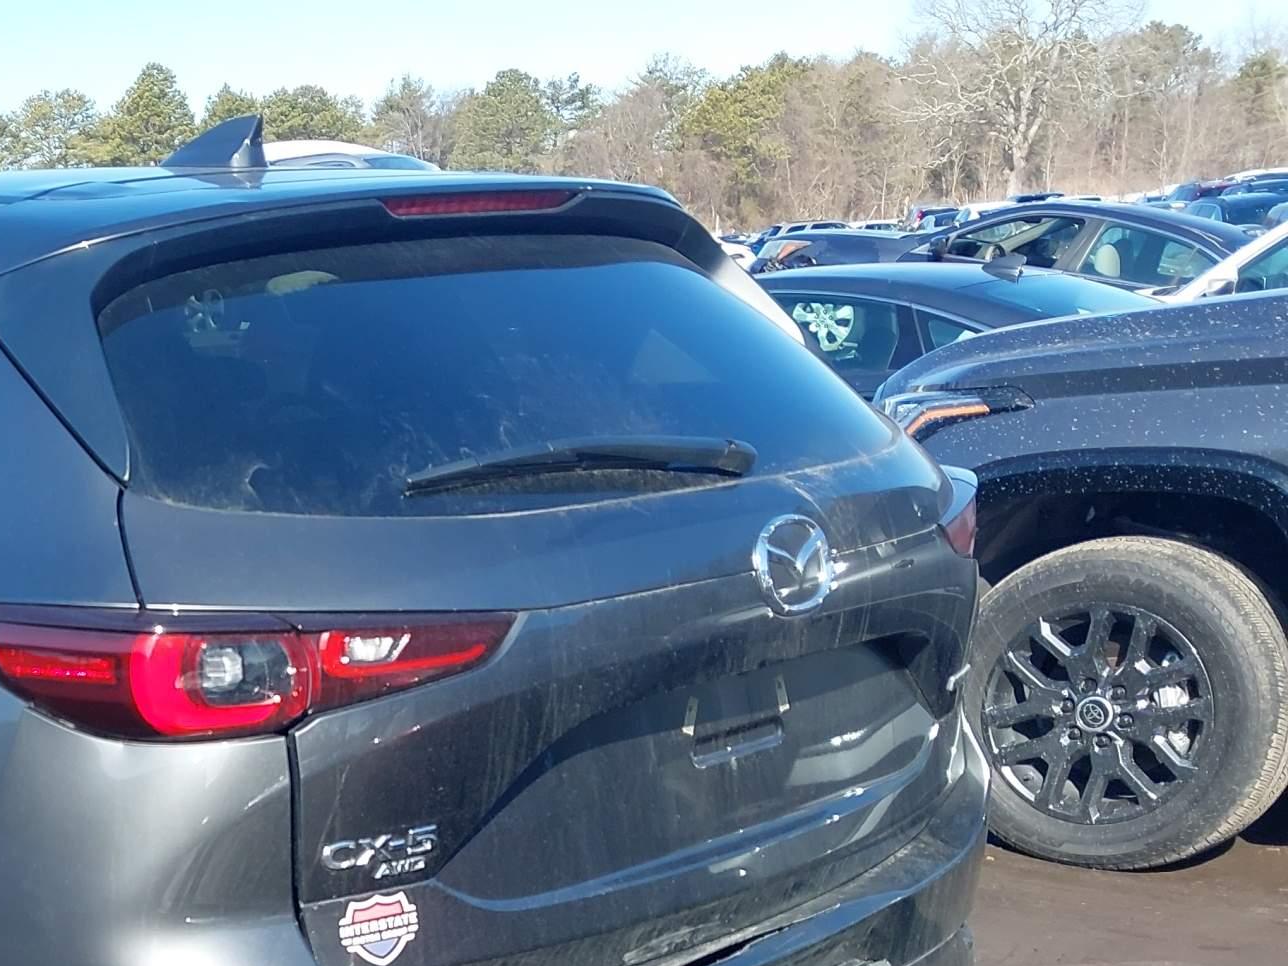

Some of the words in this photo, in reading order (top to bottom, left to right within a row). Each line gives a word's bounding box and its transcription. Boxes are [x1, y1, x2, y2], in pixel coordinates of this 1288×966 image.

[321, 825, 437, 870] CX-5
[374, 856, 426, 879] AWD
[339, 911, 418, 938] INTERSTATE
